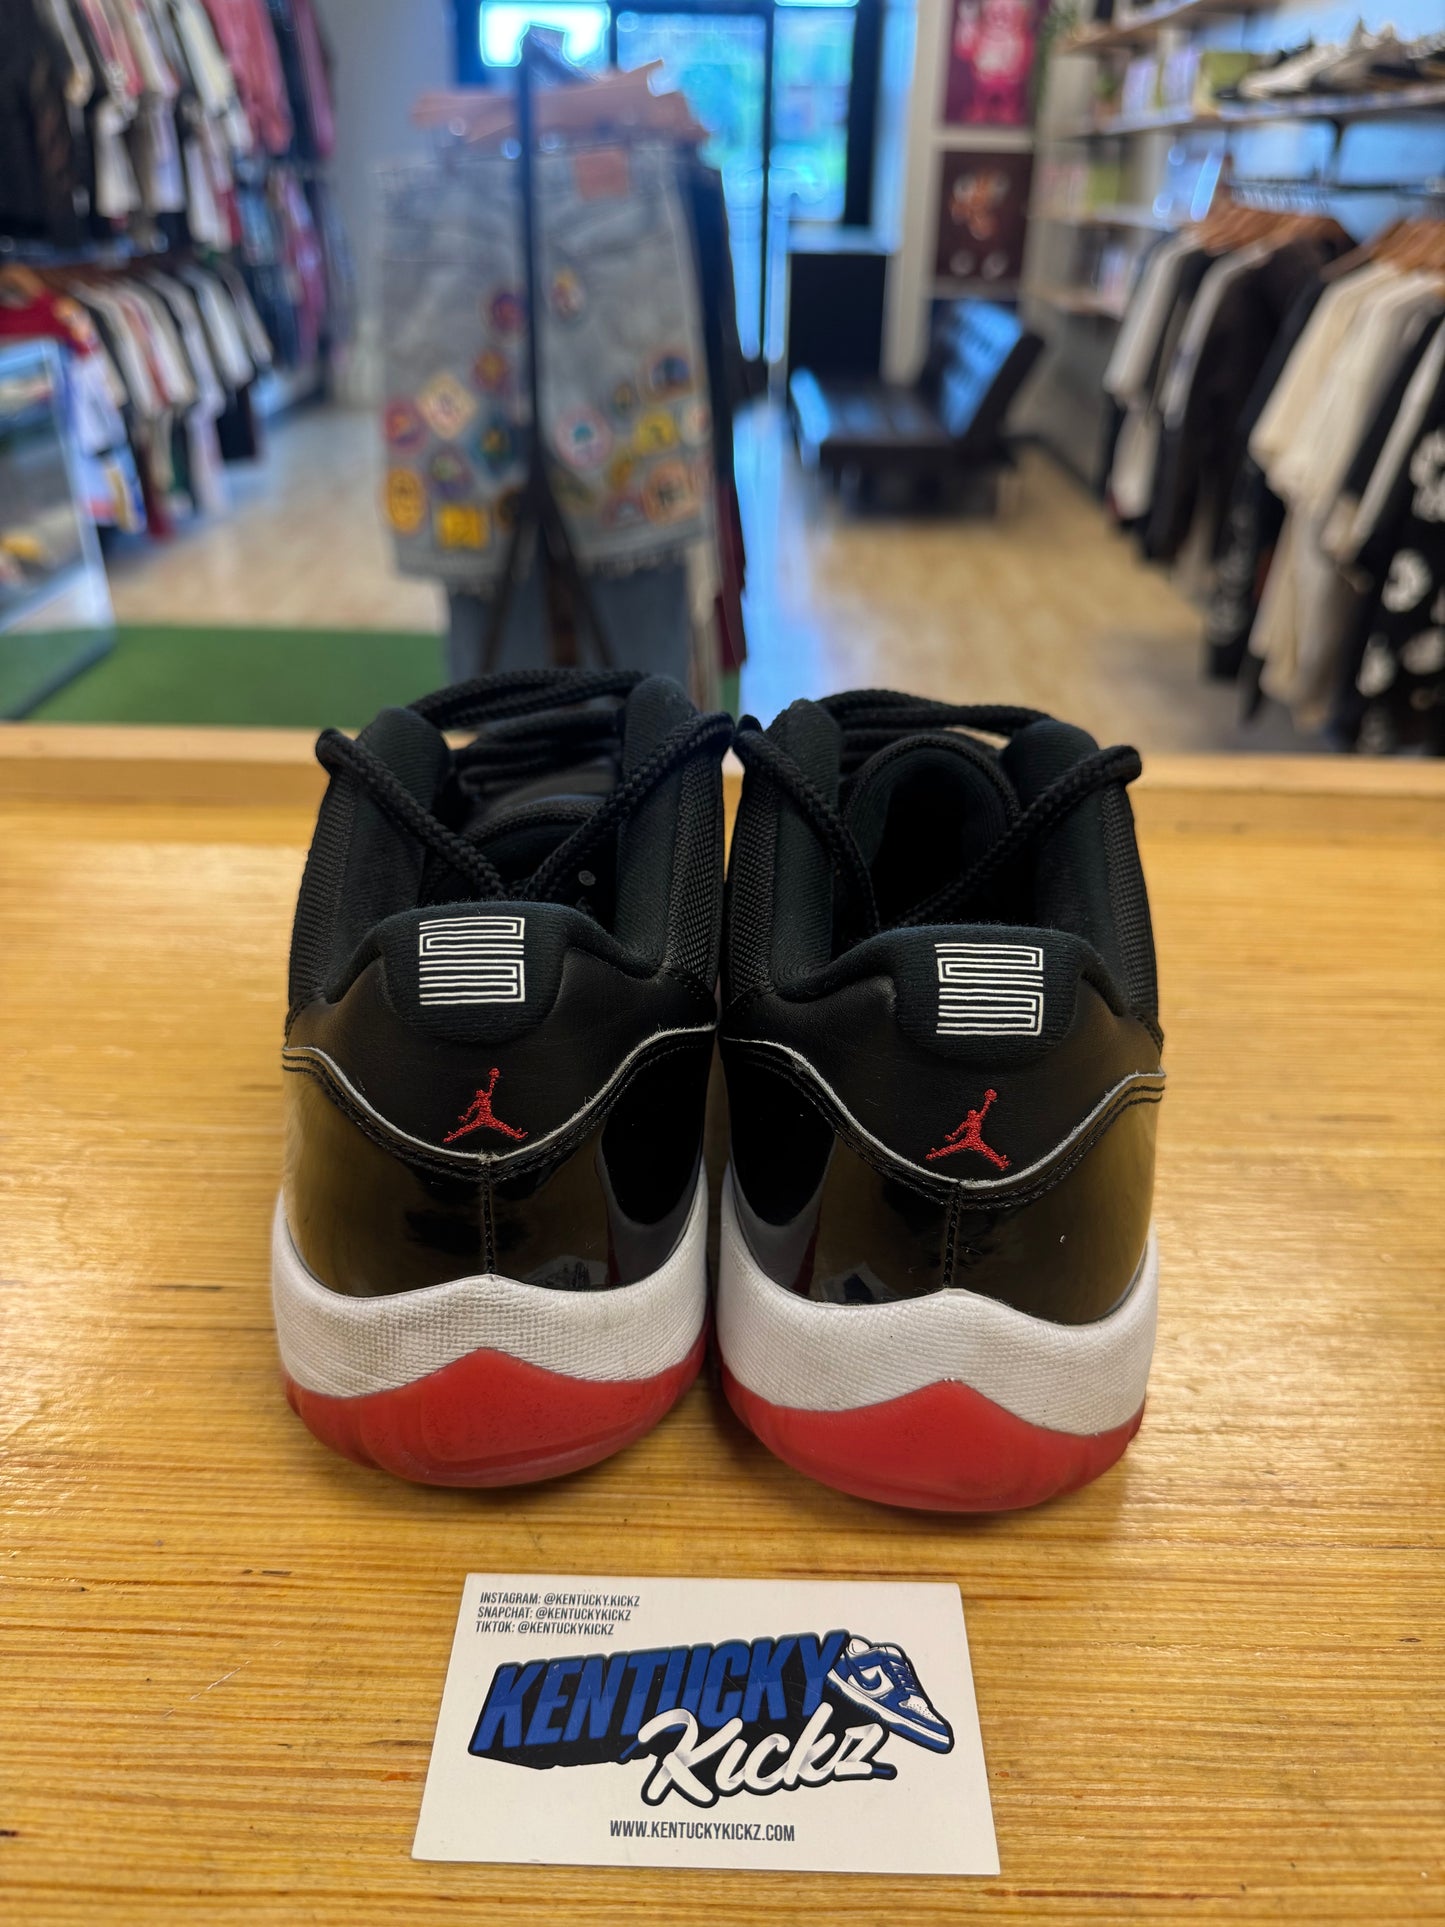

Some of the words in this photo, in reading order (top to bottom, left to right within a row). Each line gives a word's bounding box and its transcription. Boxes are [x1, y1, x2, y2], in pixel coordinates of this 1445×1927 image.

[480, 1592, 541, 1605] INSTAGRAM:
[544, 1593, 640, 1607] @KENTUCKY.KICKZ
[477, 1606, 533, 1619] SNAPCHAT:
[535, 1607, 631, 1621] @KENTUCKYKICKZ
[475, 1620, 515, 1633] TIKTOK:
[518, 1621, 615, 1636] @KENTUCKYKICKZ
[472, 1630, 850, 1752] KENTUCKY
[637, 1702, 884, 1803] Kickz
[610, 1820, 795, 1842] WWW.KENTUCKYKICKZ.COM
